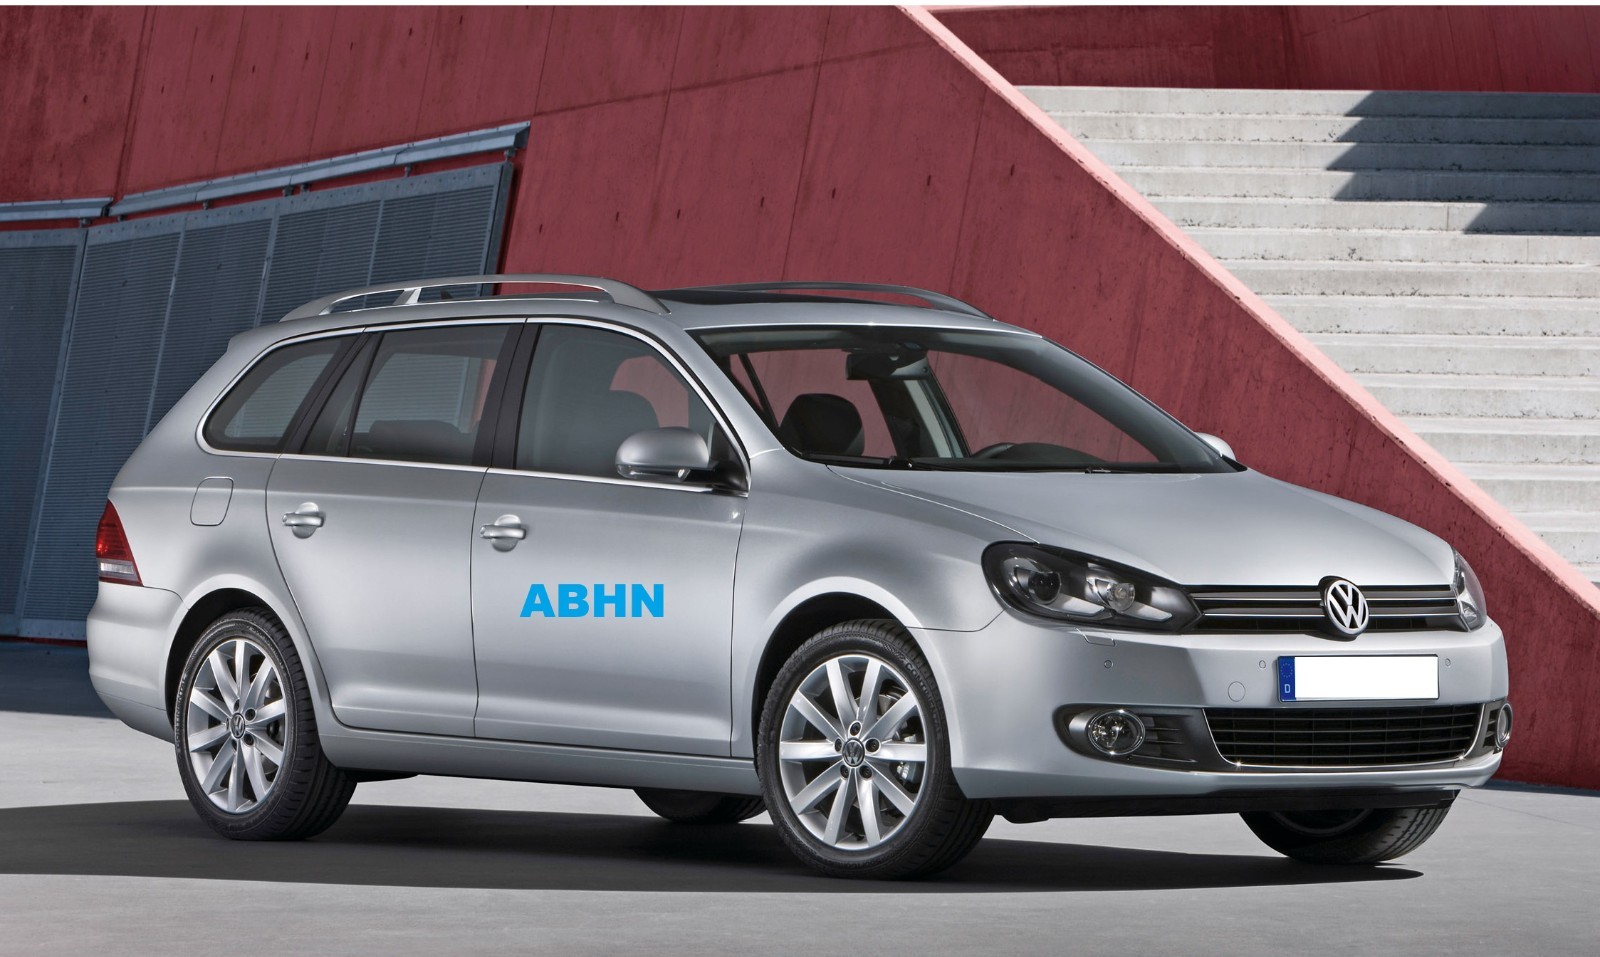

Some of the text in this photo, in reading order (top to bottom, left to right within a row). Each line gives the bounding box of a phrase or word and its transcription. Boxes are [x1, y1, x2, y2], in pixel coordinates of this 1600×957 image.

[519, 584, 664, 618] ABHN
[1327, 580, 1369, 634] VW
[1284, 684, 1291, 694] D
